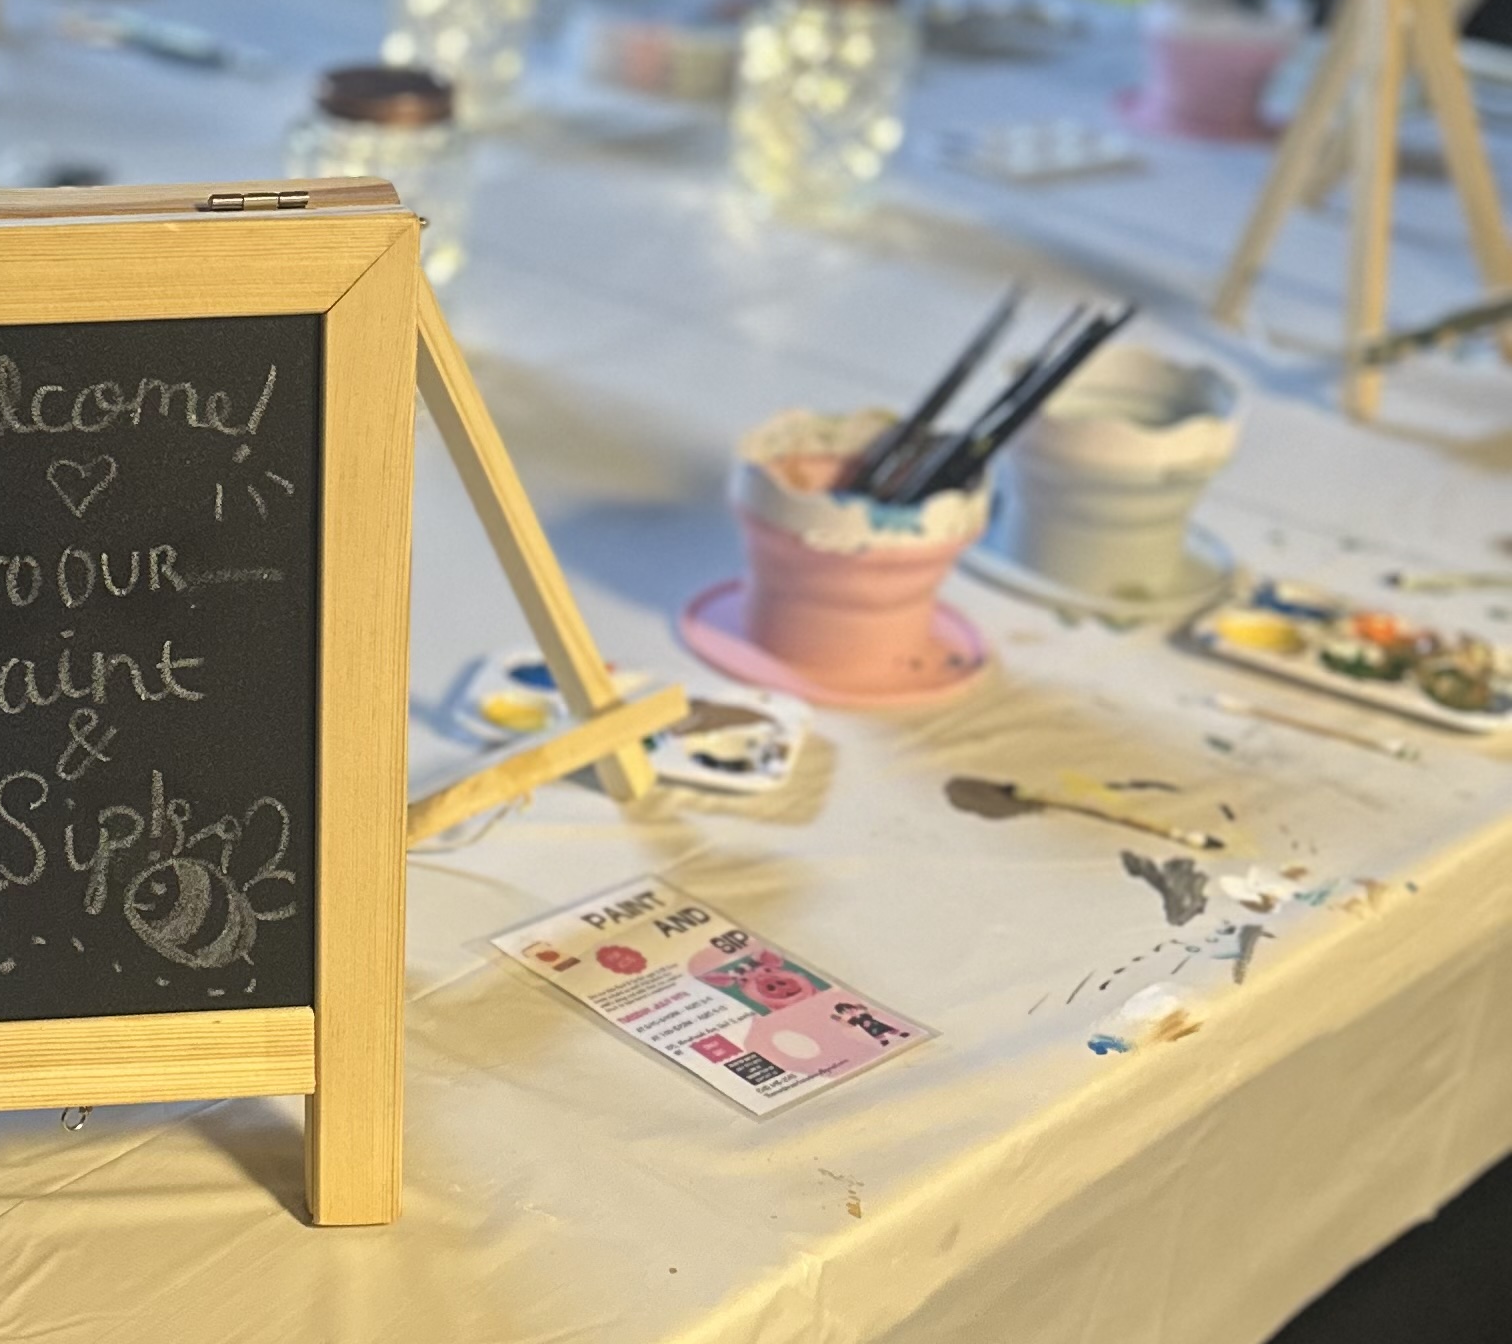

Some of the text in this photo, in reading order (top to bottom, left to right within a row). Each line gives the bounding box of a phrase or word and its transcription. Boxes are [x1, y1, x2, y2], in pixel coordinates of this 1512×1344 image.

[56, 544, 188, 608] OUR
[54, 707, 119, 781] &
[580, 891, 665, 929] PAINT
[653, 907, 710, 938] AND
[710, 929, 749, 954] SIP
